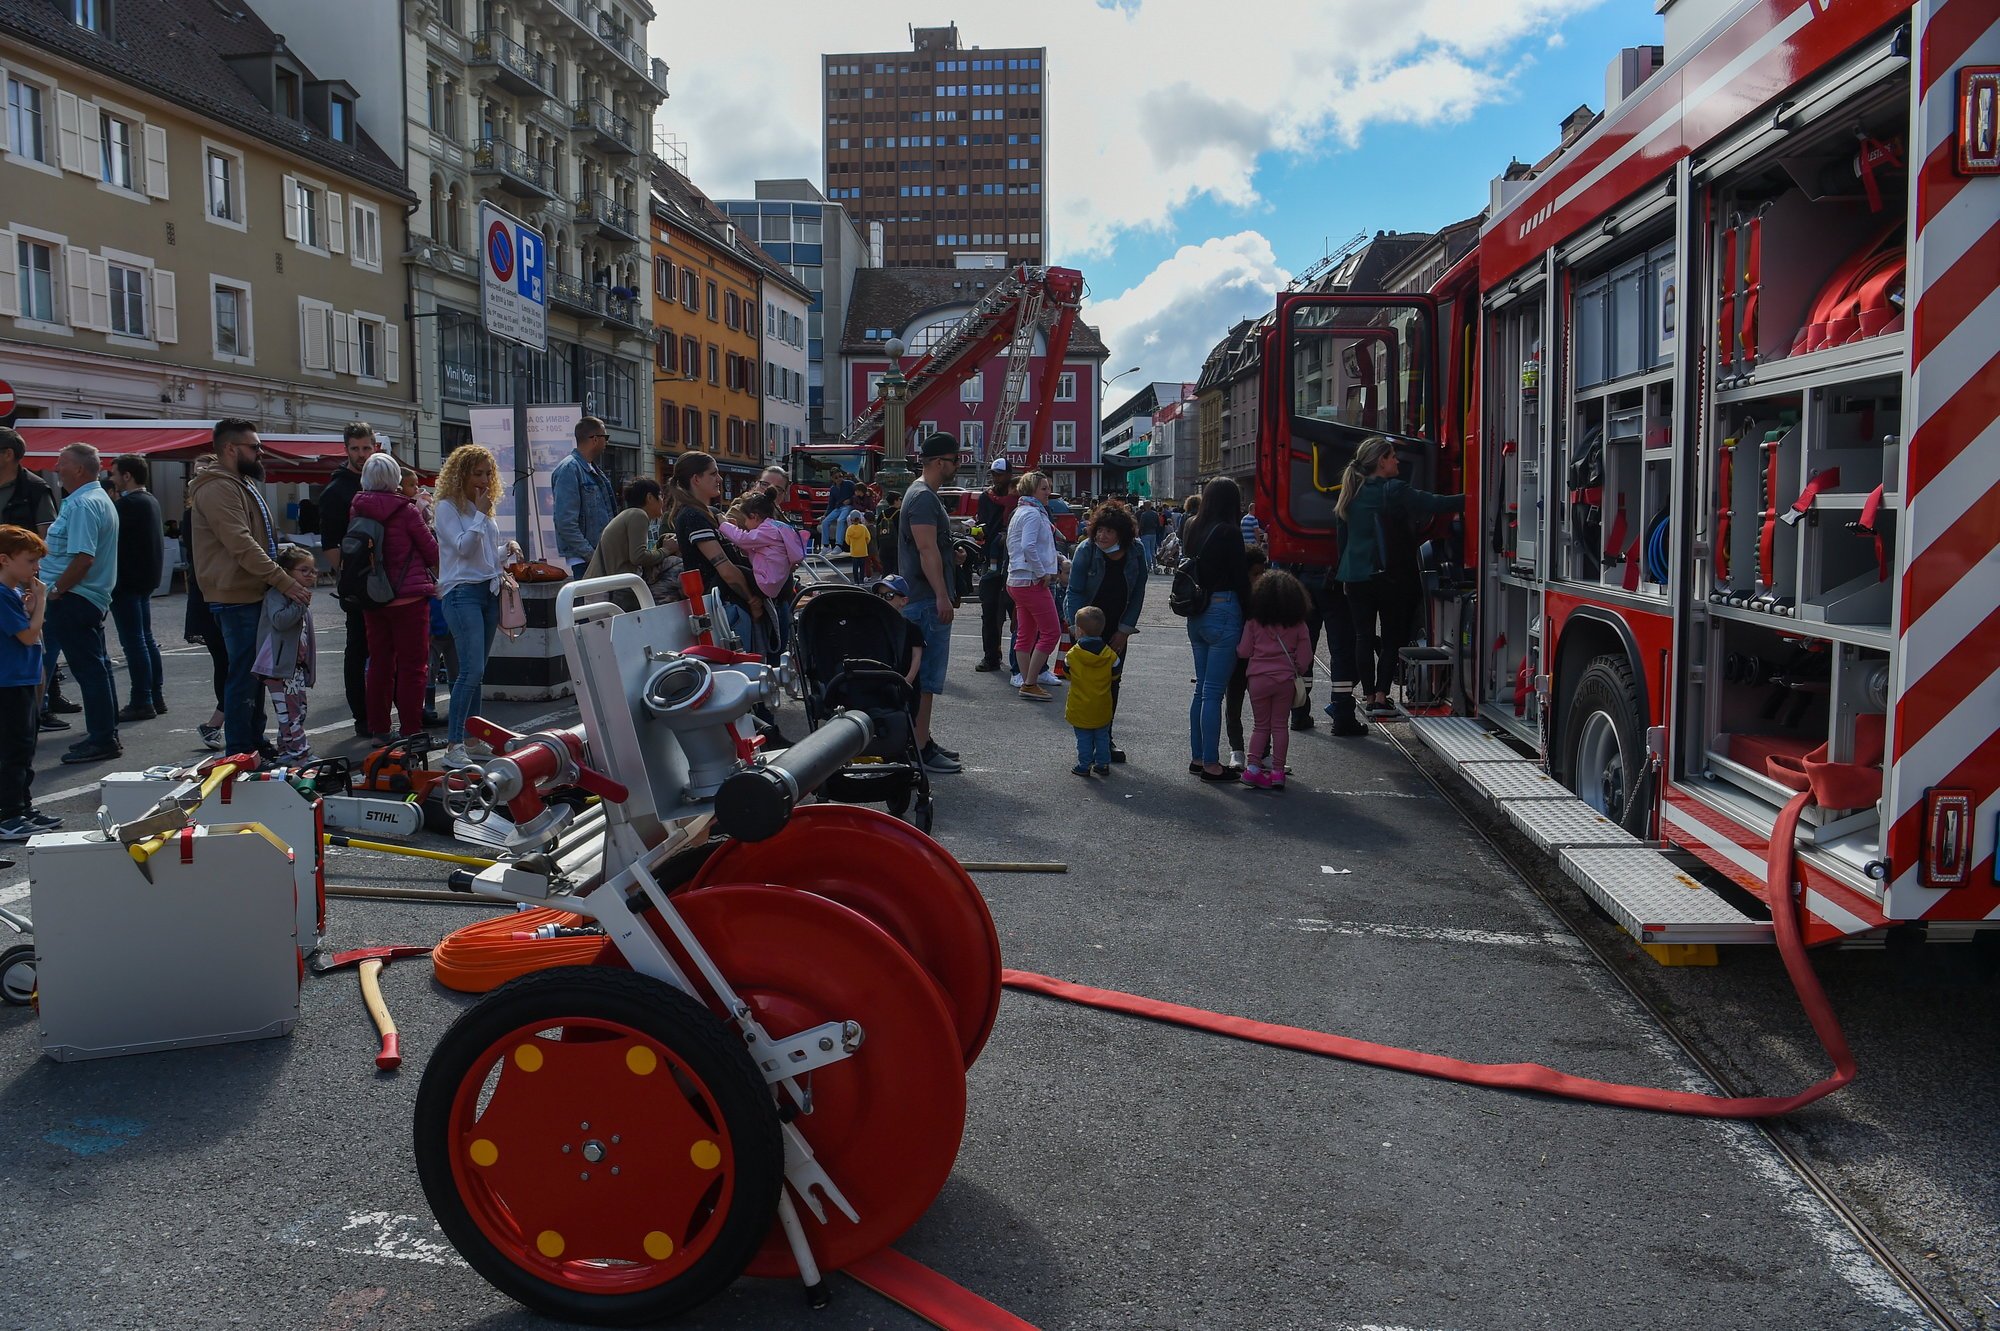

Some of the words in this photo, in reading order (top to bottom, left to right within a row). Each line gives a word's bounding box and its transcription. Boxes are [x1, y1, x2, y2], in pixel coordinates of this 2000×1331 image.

[522, 236, 535, 282] P
[445, 364, 459, 380] Vini
[461, 368, 476, 387] Yoga
[365, 810, 399, 824] STIHL
